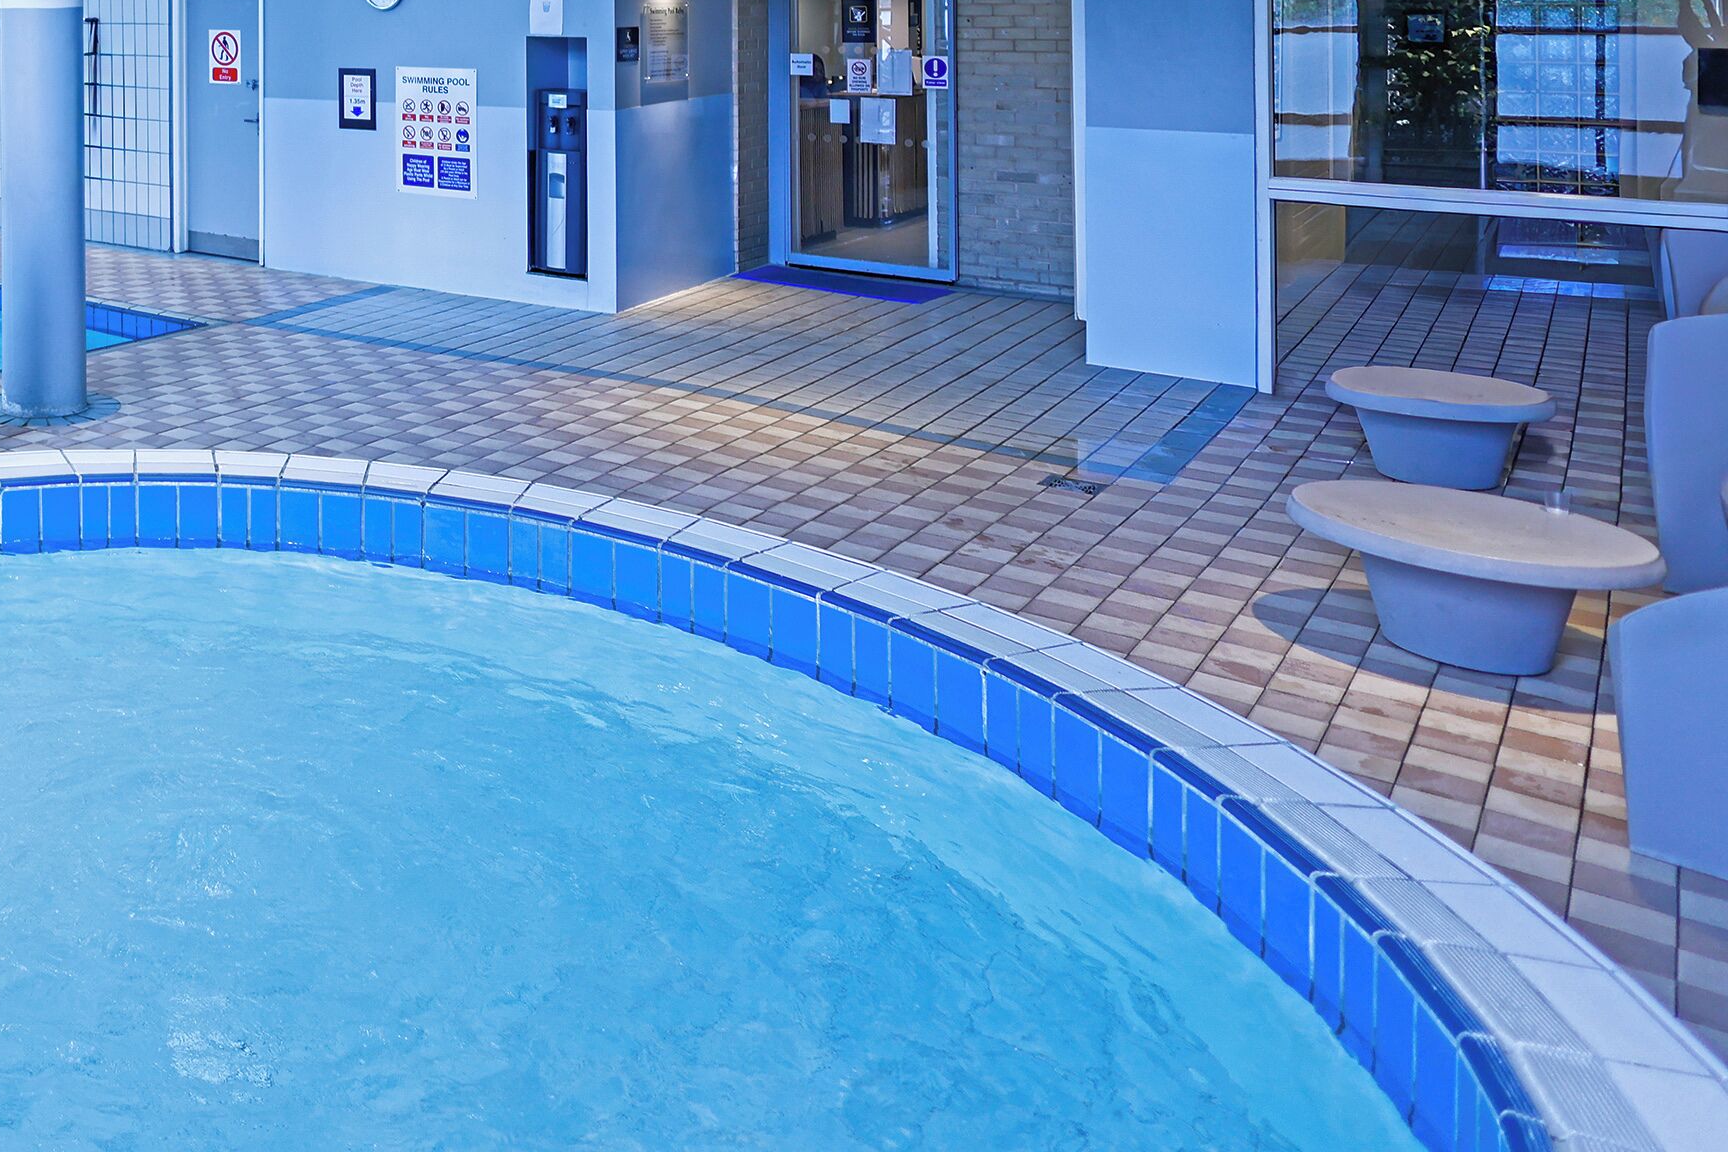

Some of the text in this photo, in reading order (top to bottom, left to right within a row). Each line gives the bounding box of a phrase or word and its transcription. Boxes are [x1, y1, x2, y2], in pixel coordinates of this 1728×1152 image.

[402, 76, 470, 86] SWIMMING POOL
[422, 86, 448, 94] RULES
